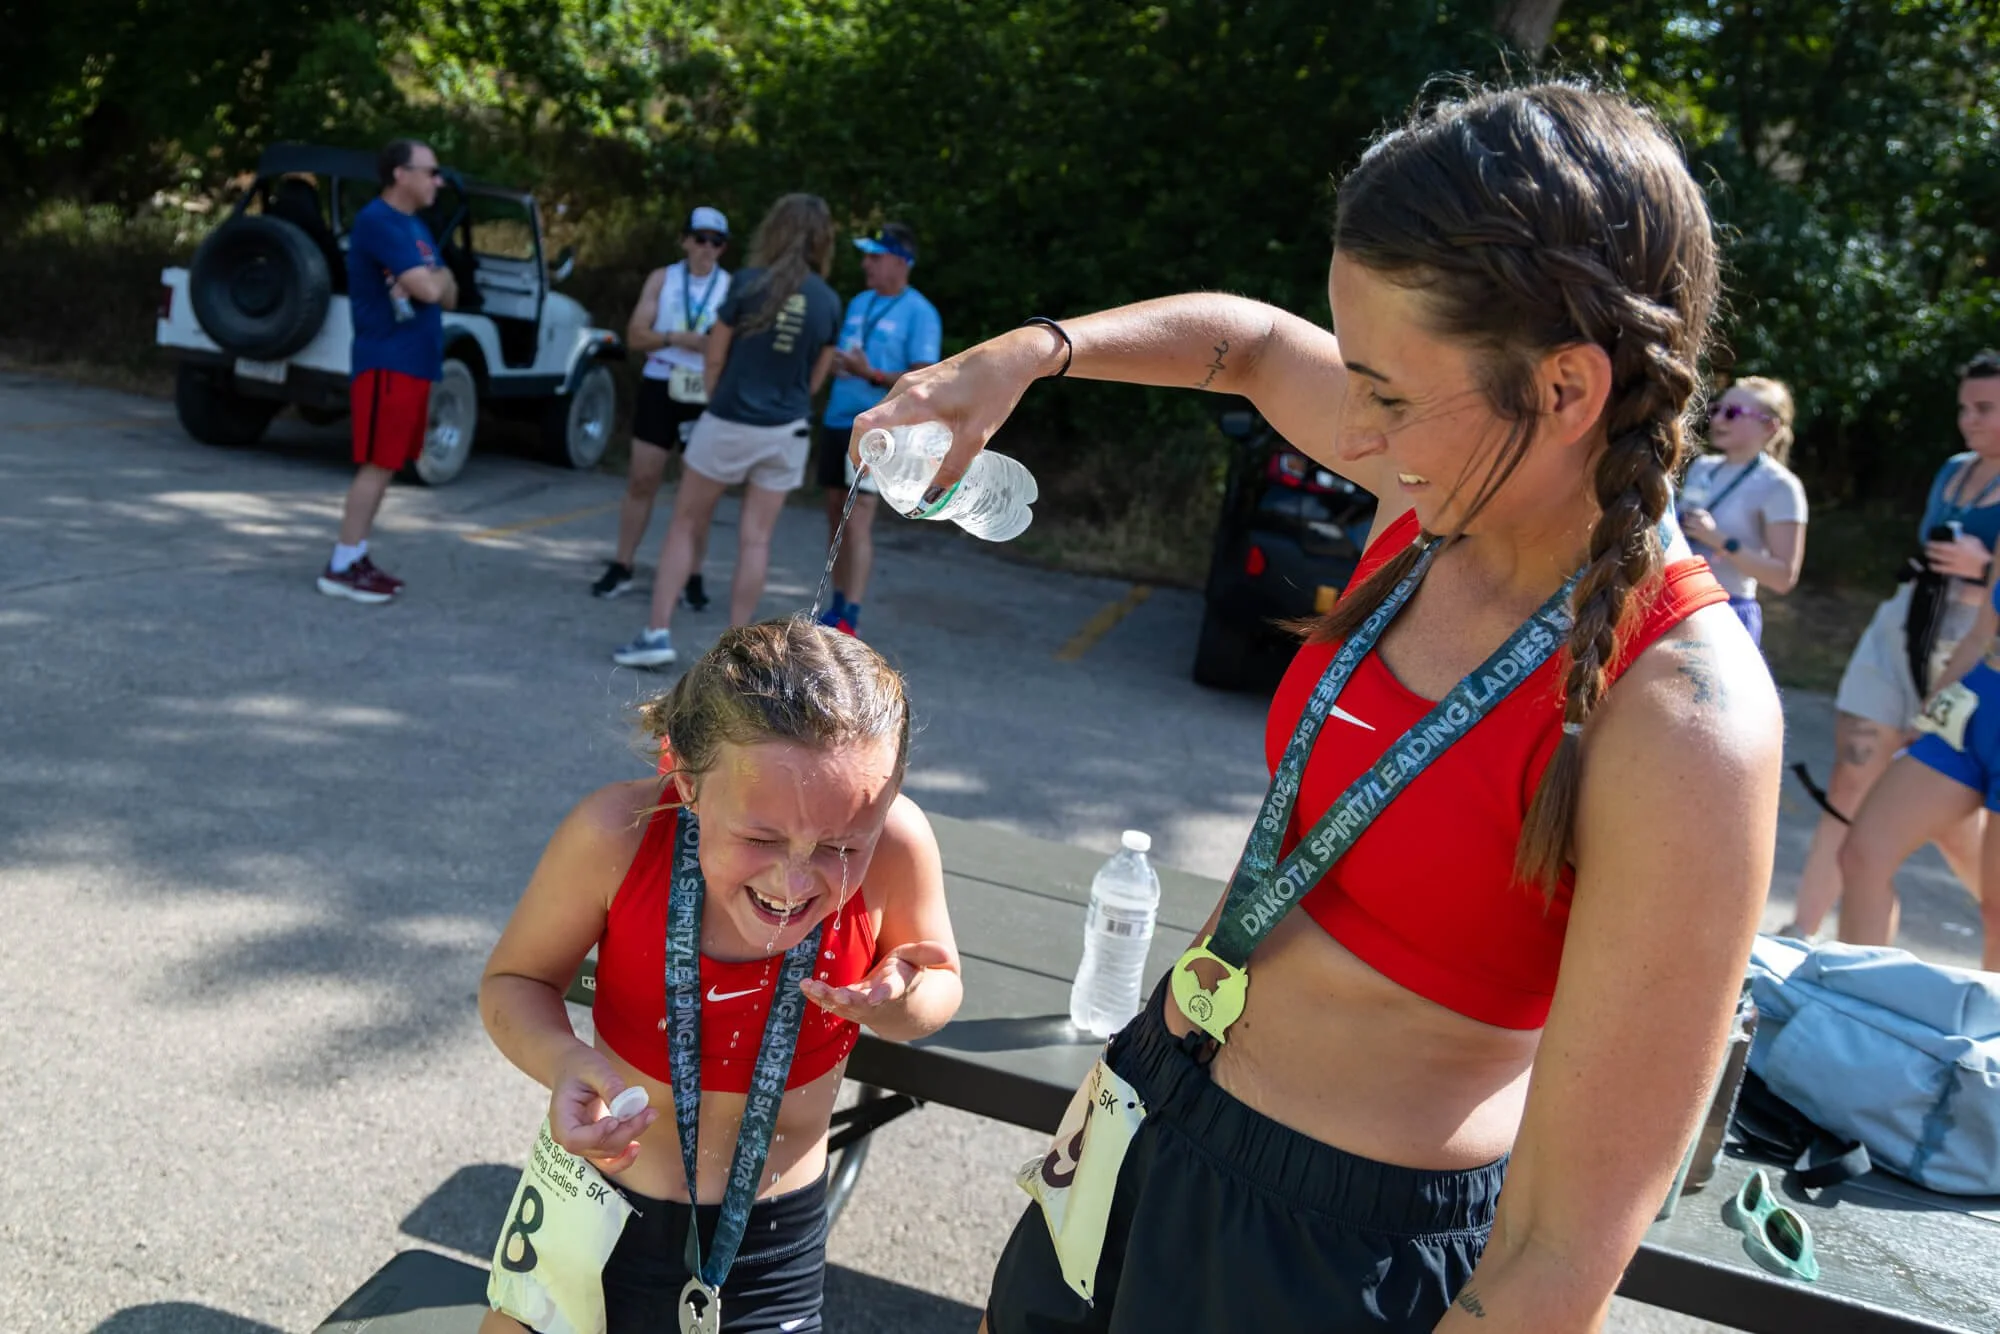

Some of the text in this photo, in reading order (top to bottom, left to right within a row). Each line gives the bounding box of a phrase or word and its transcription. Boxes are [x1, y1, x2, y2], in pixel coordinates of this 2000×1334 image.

[1311, 633, 1368, 715] LADIES
[1293, 718, 1316, 750] 5K
[1240, 858, 1318, 936] DAKOTA
[1311, 702, 1470, 862] SPIRIT/LEADING
[1464, 625, 1553, 708] LADIES
[1262, 779, 1292, 833] 2026
[758, 1021, 794, 1092] LADIES
[677, 1049, 697, 1125] LADIES
[750, 1095, 773, 1122] 5K
[1099, 1088, 1119, 1115] 5K
[548, 1163, 579, 1197] Ladies
[552, 1145, 575, 1173] Spirit
[575, 1166, 586, 1181] &
[734, 1146, 758, 1190] 2026
[586, 1182, 610, 1205] 5K
[501, 1185, 544, 1273] 8
